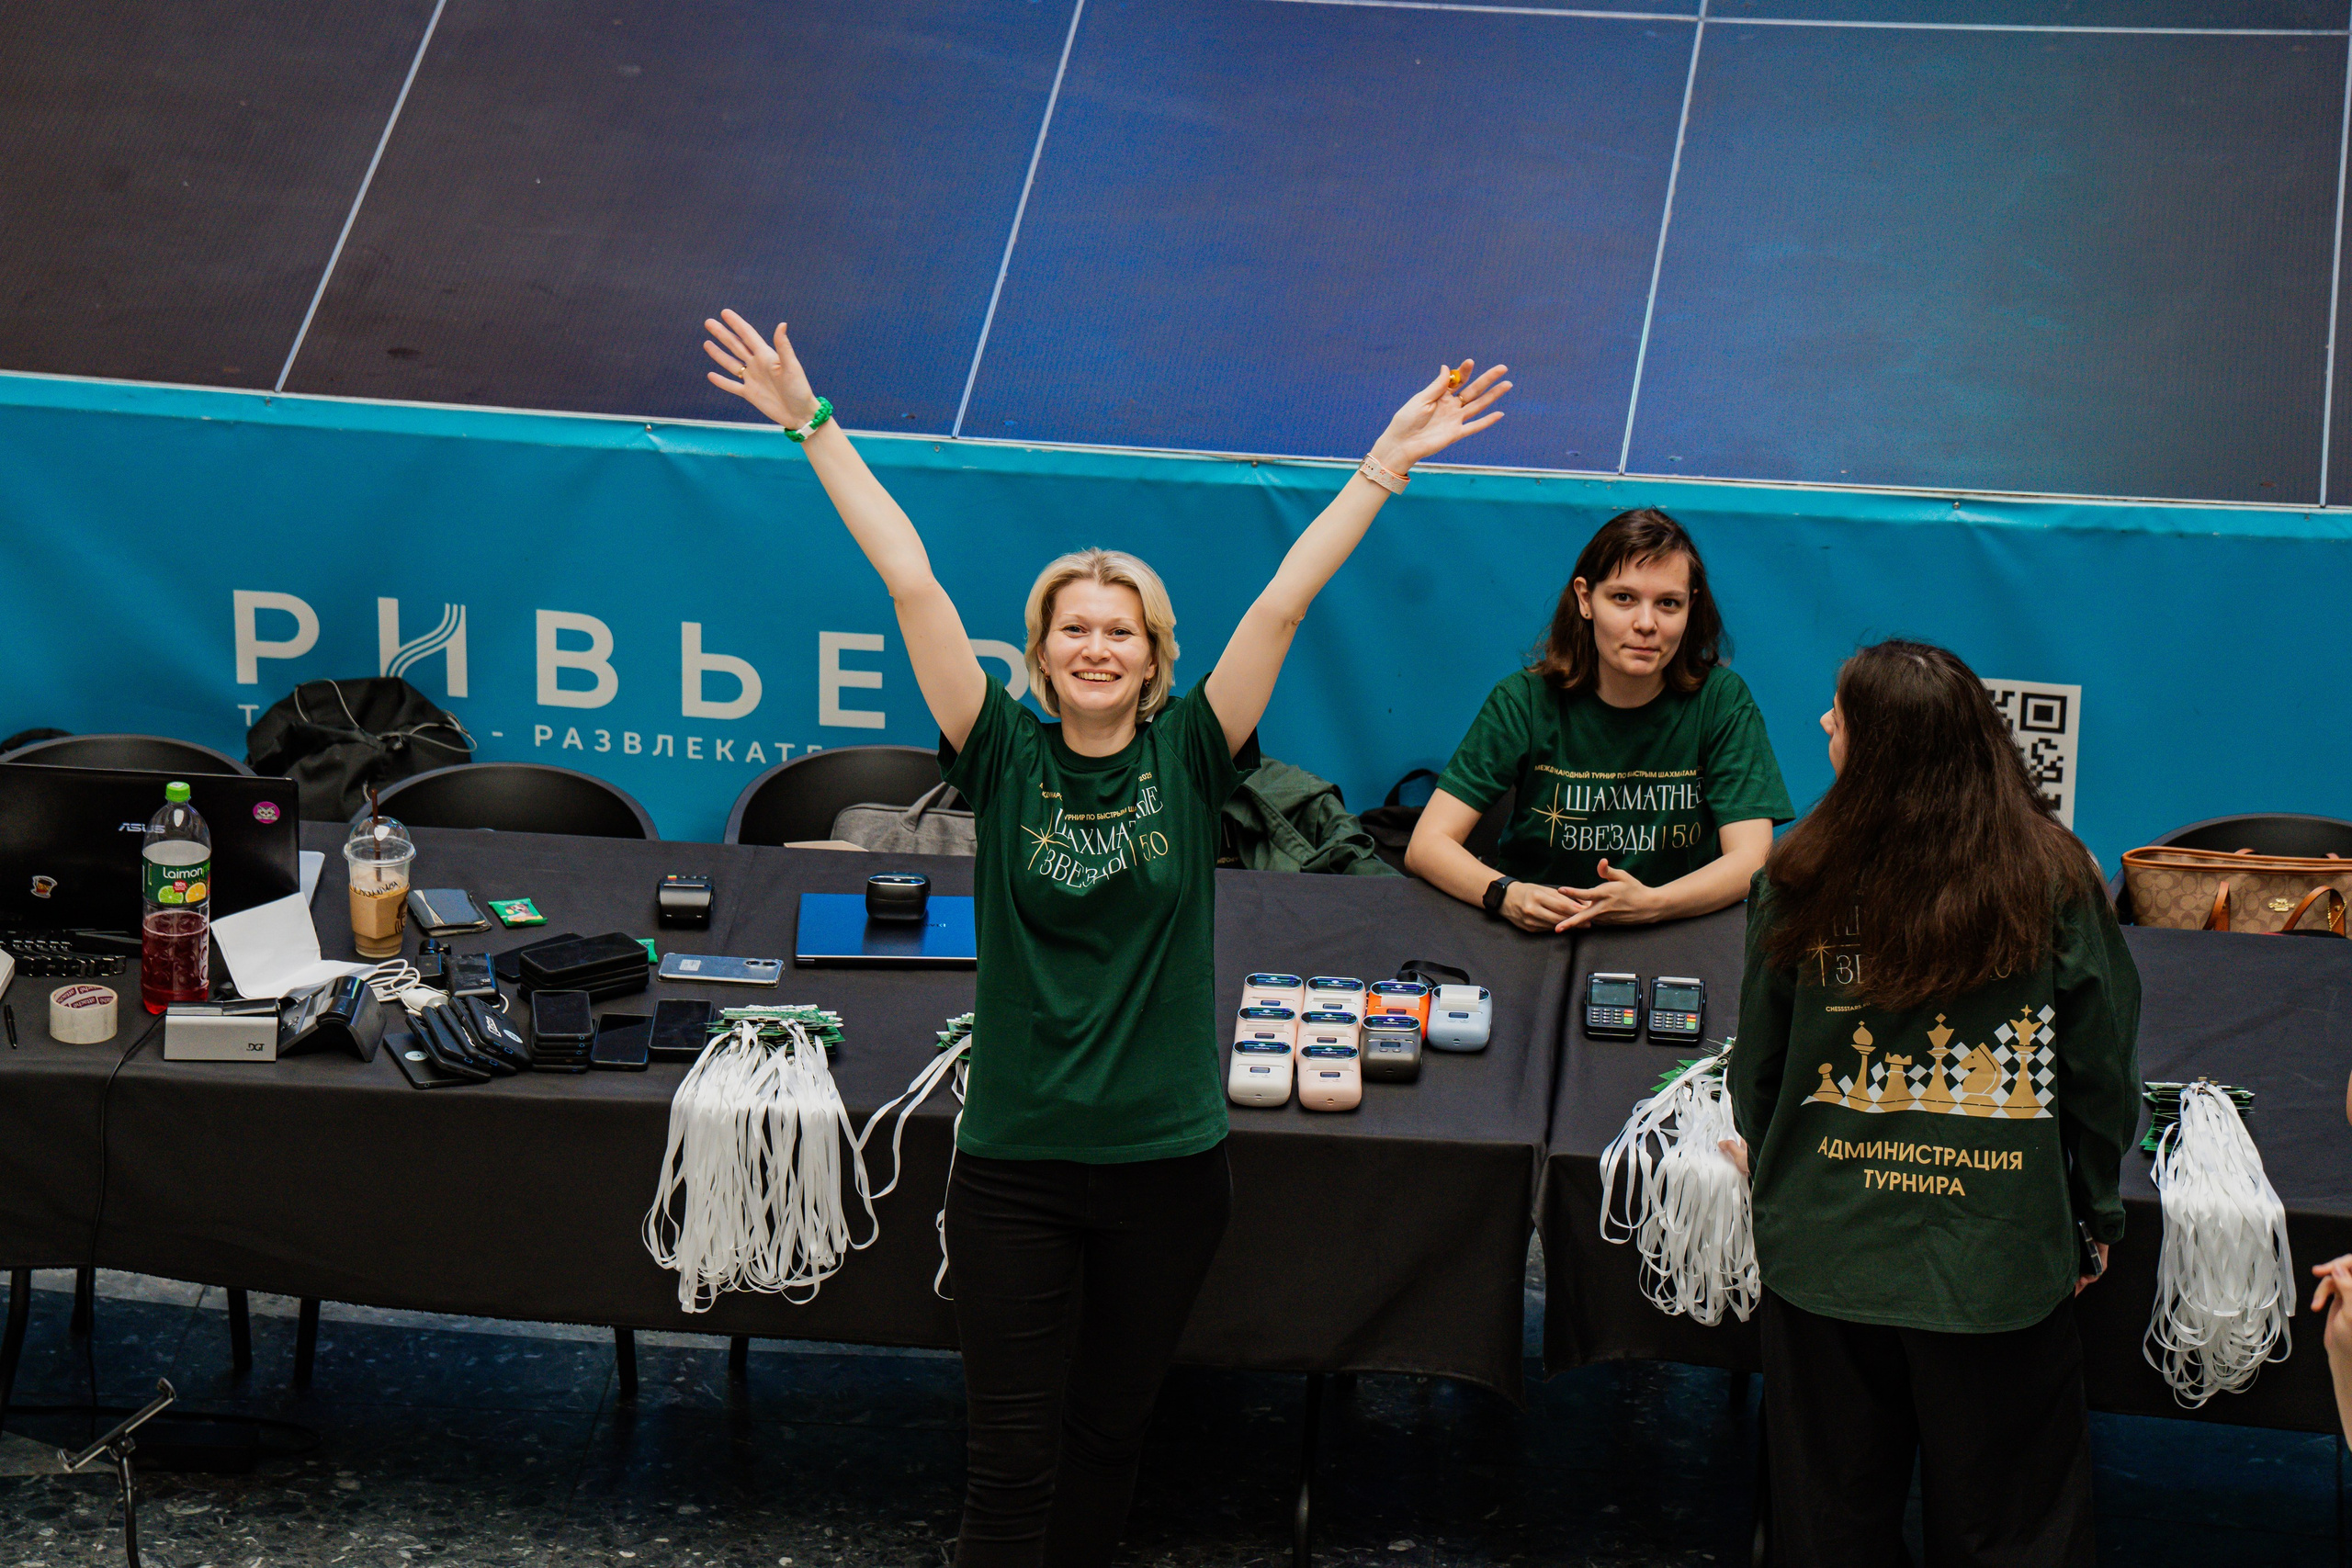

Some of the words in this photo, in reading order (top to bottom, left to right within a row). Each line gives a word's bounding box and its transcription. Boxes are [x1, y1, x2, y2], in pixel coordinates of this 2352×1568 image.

[534, 724, 823, 764] РАЗВЛЕКАТ
[119, 822, 165, 834] ASUS
[1086, 814, 1096, 822] ПО
[1562, 822, 1656, 855] ЗВЕЗДЫ
[1817, 1135, 2023, 1171] АДМИНИСТРАЦИЯ
[1863, 1168, 1966, 1197] ТУРНИРА
